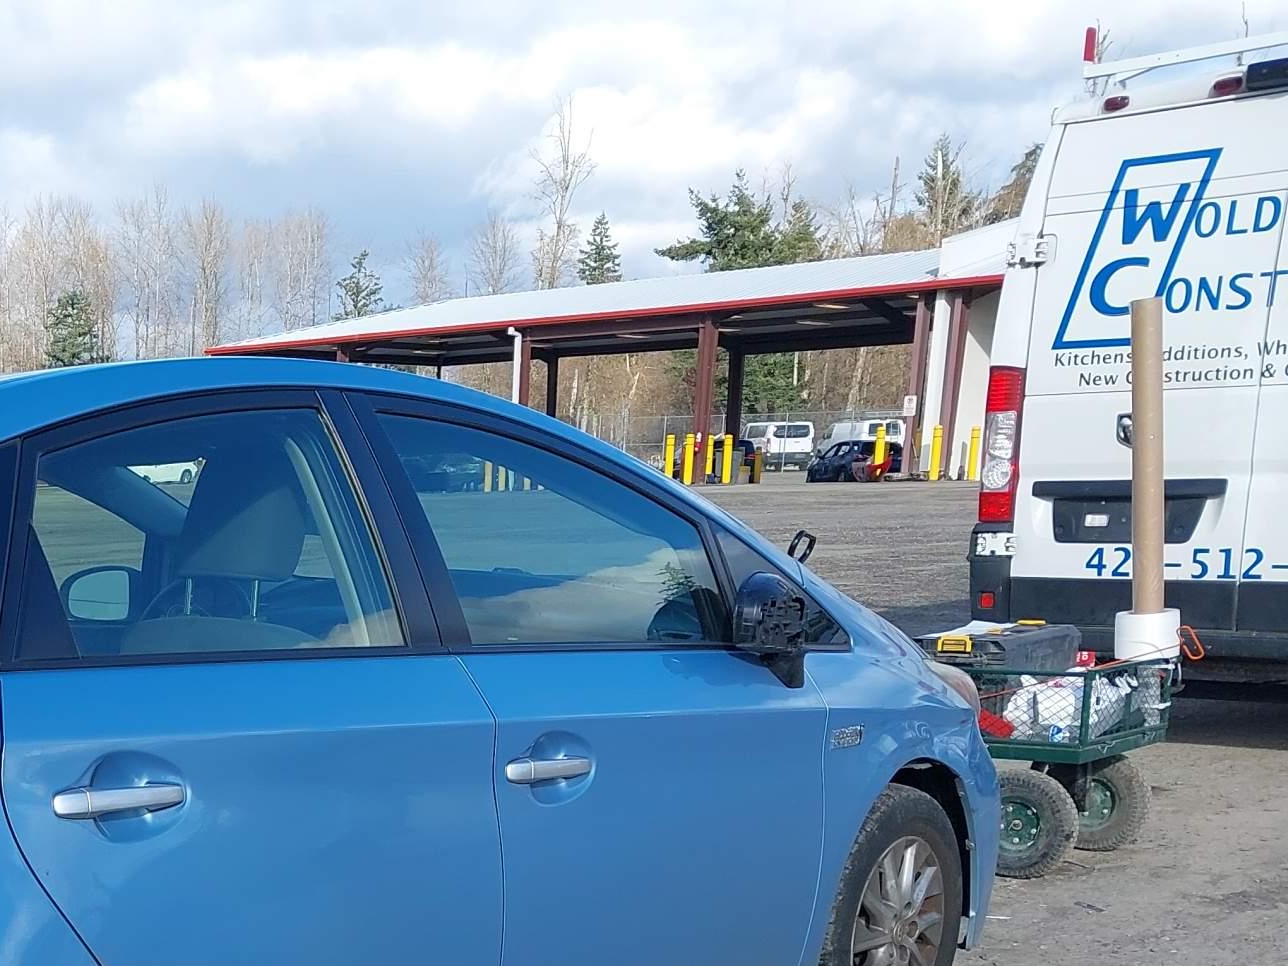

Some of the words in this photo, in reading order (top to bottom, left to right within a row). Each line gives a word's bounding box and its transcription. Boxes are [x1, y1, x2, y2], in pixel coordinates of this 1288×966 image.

[1162, 344, 1249, 361] dditions,
[1079, 372, 1119, 387] New
[1261, 363, 1277, 379] &
